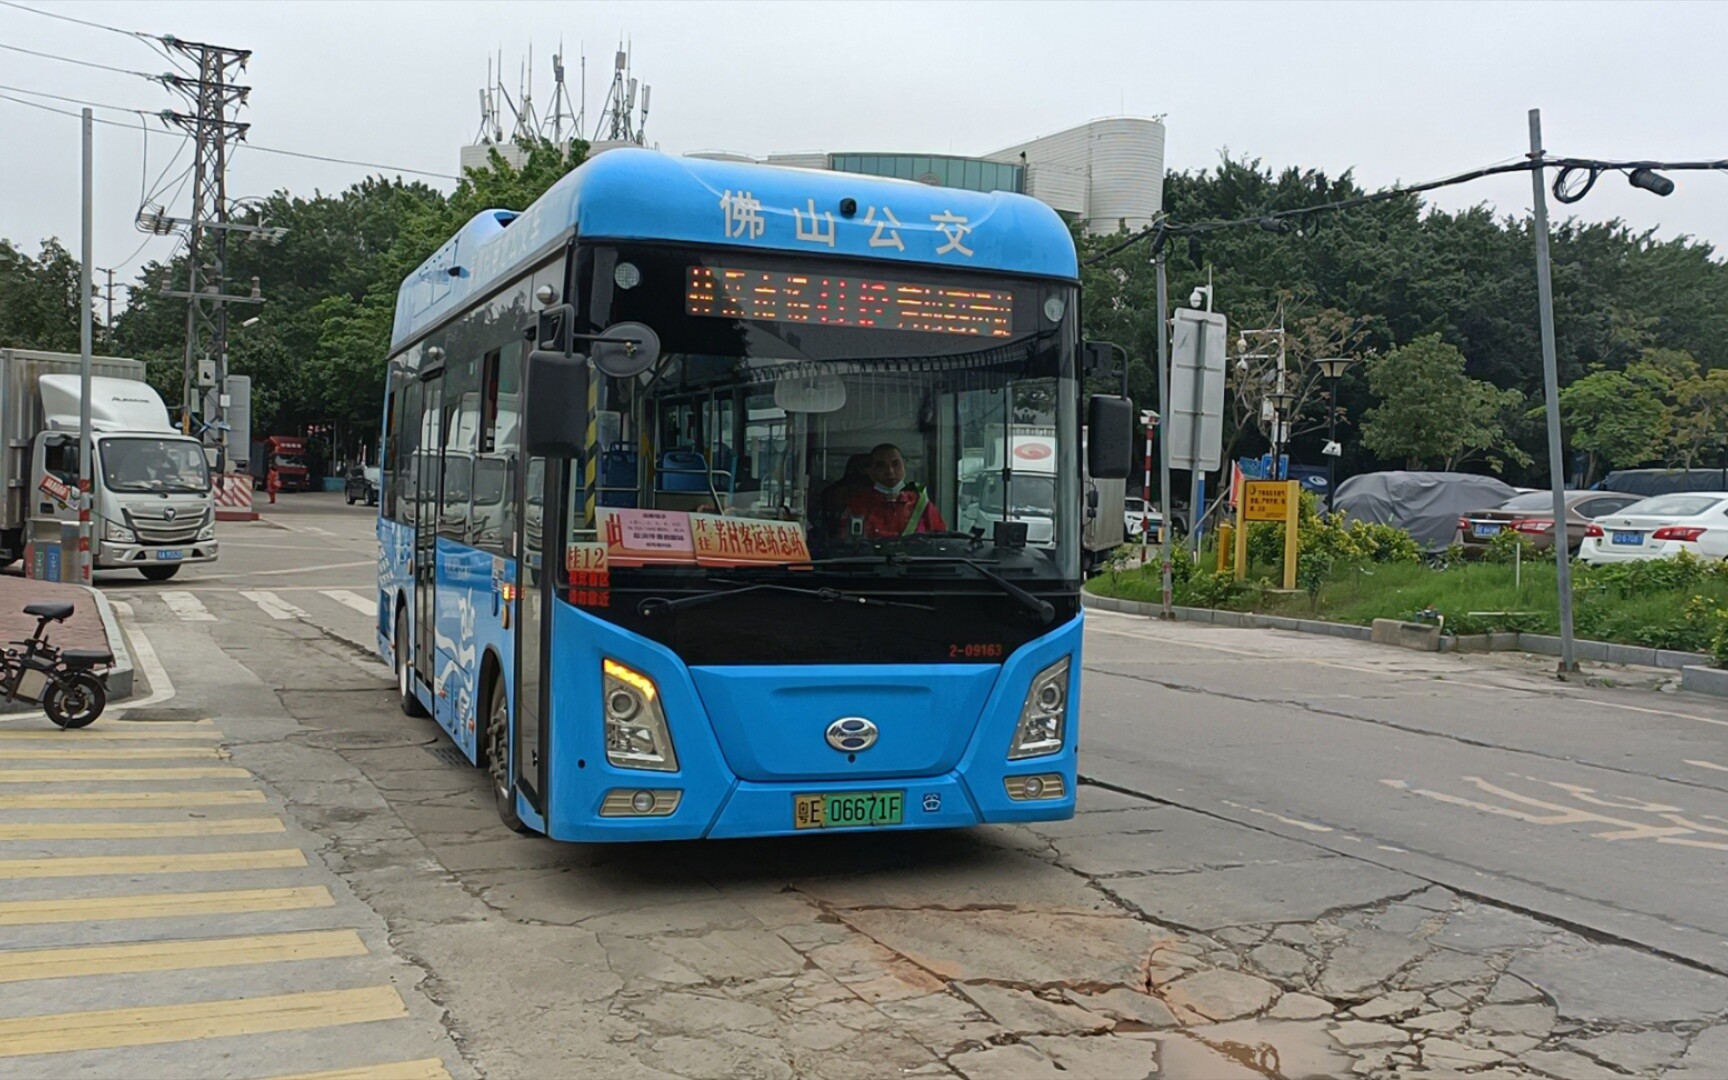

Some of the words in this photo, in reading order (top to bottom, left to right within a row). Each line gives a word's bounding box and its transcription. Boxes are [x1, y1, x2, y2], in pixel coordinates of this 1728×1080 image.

[719, 189, 975, 258] 佛山公交
[694, 518, 713, 551] 开往
[713, 519, 806, 557] 芳村客运站总站
[567, 545, 606, 569] 桂12
[948, 643, 1003, 658] 2-09163
[831, 796, 901, 822] 06671F
